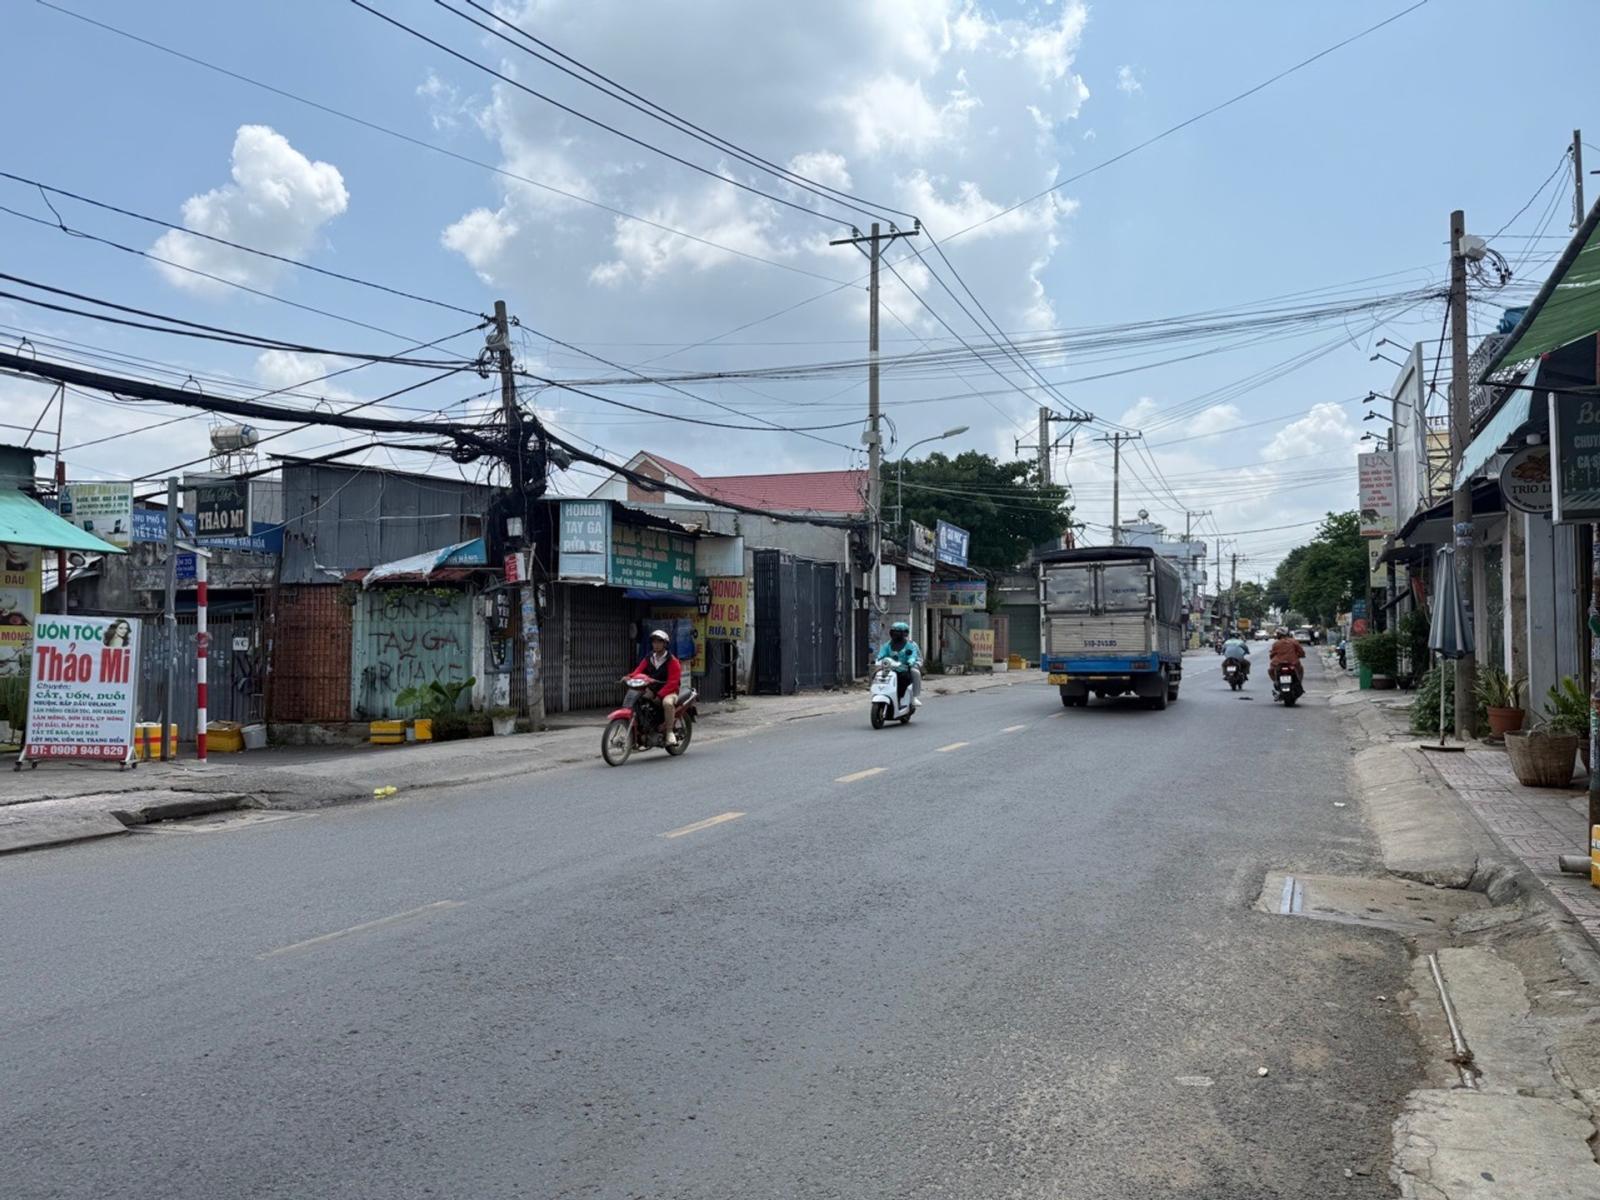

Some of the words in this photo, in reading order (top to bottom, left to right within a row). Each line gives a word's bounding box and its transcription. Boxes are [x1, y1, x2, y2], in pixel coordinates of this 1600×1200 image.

[1512, 484, 1539, 495] TRIO
[565, 503, 602, 516] HONDA
[199, 503, 228, 530] THẢO
[230, 509, 244, 528] MI
[565, 521, 584, 534] TAY
[587, 521, 602, 534] GA
[711, 581, 743, 598] HONDA
[711, 604, 725, 621] TAY
[728, 605, 740, 622] GA
[36, 621, 70, 641] UỐN
[730, 627, 742, 637] XE
[36, 642, 92, 683] Thảo
[99, 648, 130, 684] Mi
[66, 691, 94, 701] UỐN,
[31, 745, 48, 755] ĐT:
[50, 745, 78, 755] 0909
